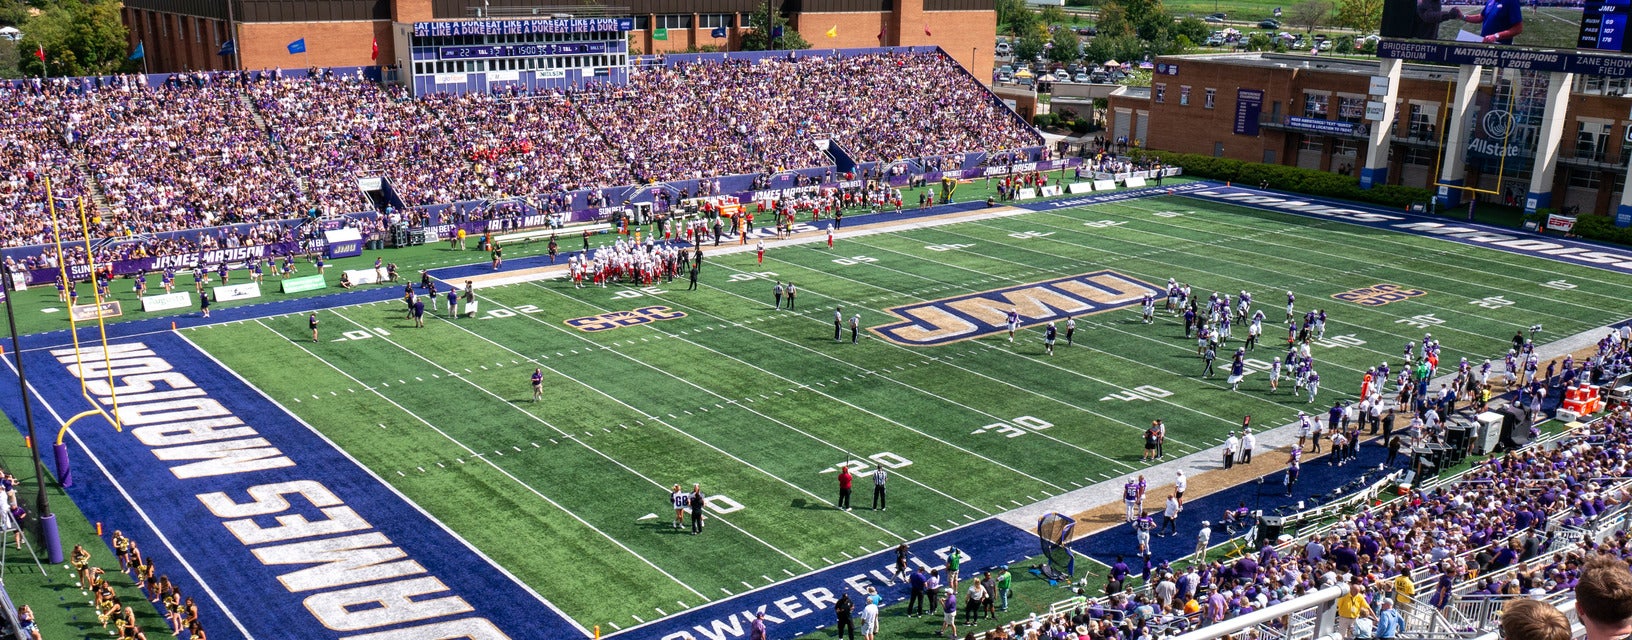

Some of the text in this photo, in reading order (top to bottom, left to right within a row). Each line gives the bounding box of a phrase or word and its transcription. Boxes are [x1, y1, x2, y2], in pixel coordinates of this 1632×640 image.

[486, 21, 501, 29] EAT
[518, 46, 536, 54] 15:00
[1382, 42, 1436, 53] BRIDGEFORTH
[1390, 50, 1426, 60] STADIUM
[1454, 48, 1558, 62] NATIONAL CHAMPIONS
[1576, 56, 1600, 66] ZANE
[1473, 57, 1532, 68] 2004 2016
[1598, 66, 1625, 76] FIELD
[1468, 138, 1519, 157] Allstate
[984, 165, 1006, 176] JAMES
[752, 189, 780, 201] JAMES
[1194, 191, 1405, 222] JAMES
[334, 244, 356, 254] JMU
[152, 246, 264, 269] JAMES MADISON
[71, 264, 90, 274] SUN
[867, 270, 1169, 346] JMU
[1109, 384, 1175, 402] 40
[50, 342, 296, 480] MADISON
[986, 415, 1054, 438] 30
[836, 451, 913, 478] 20
[844, 546, 972, 596] FIELD
